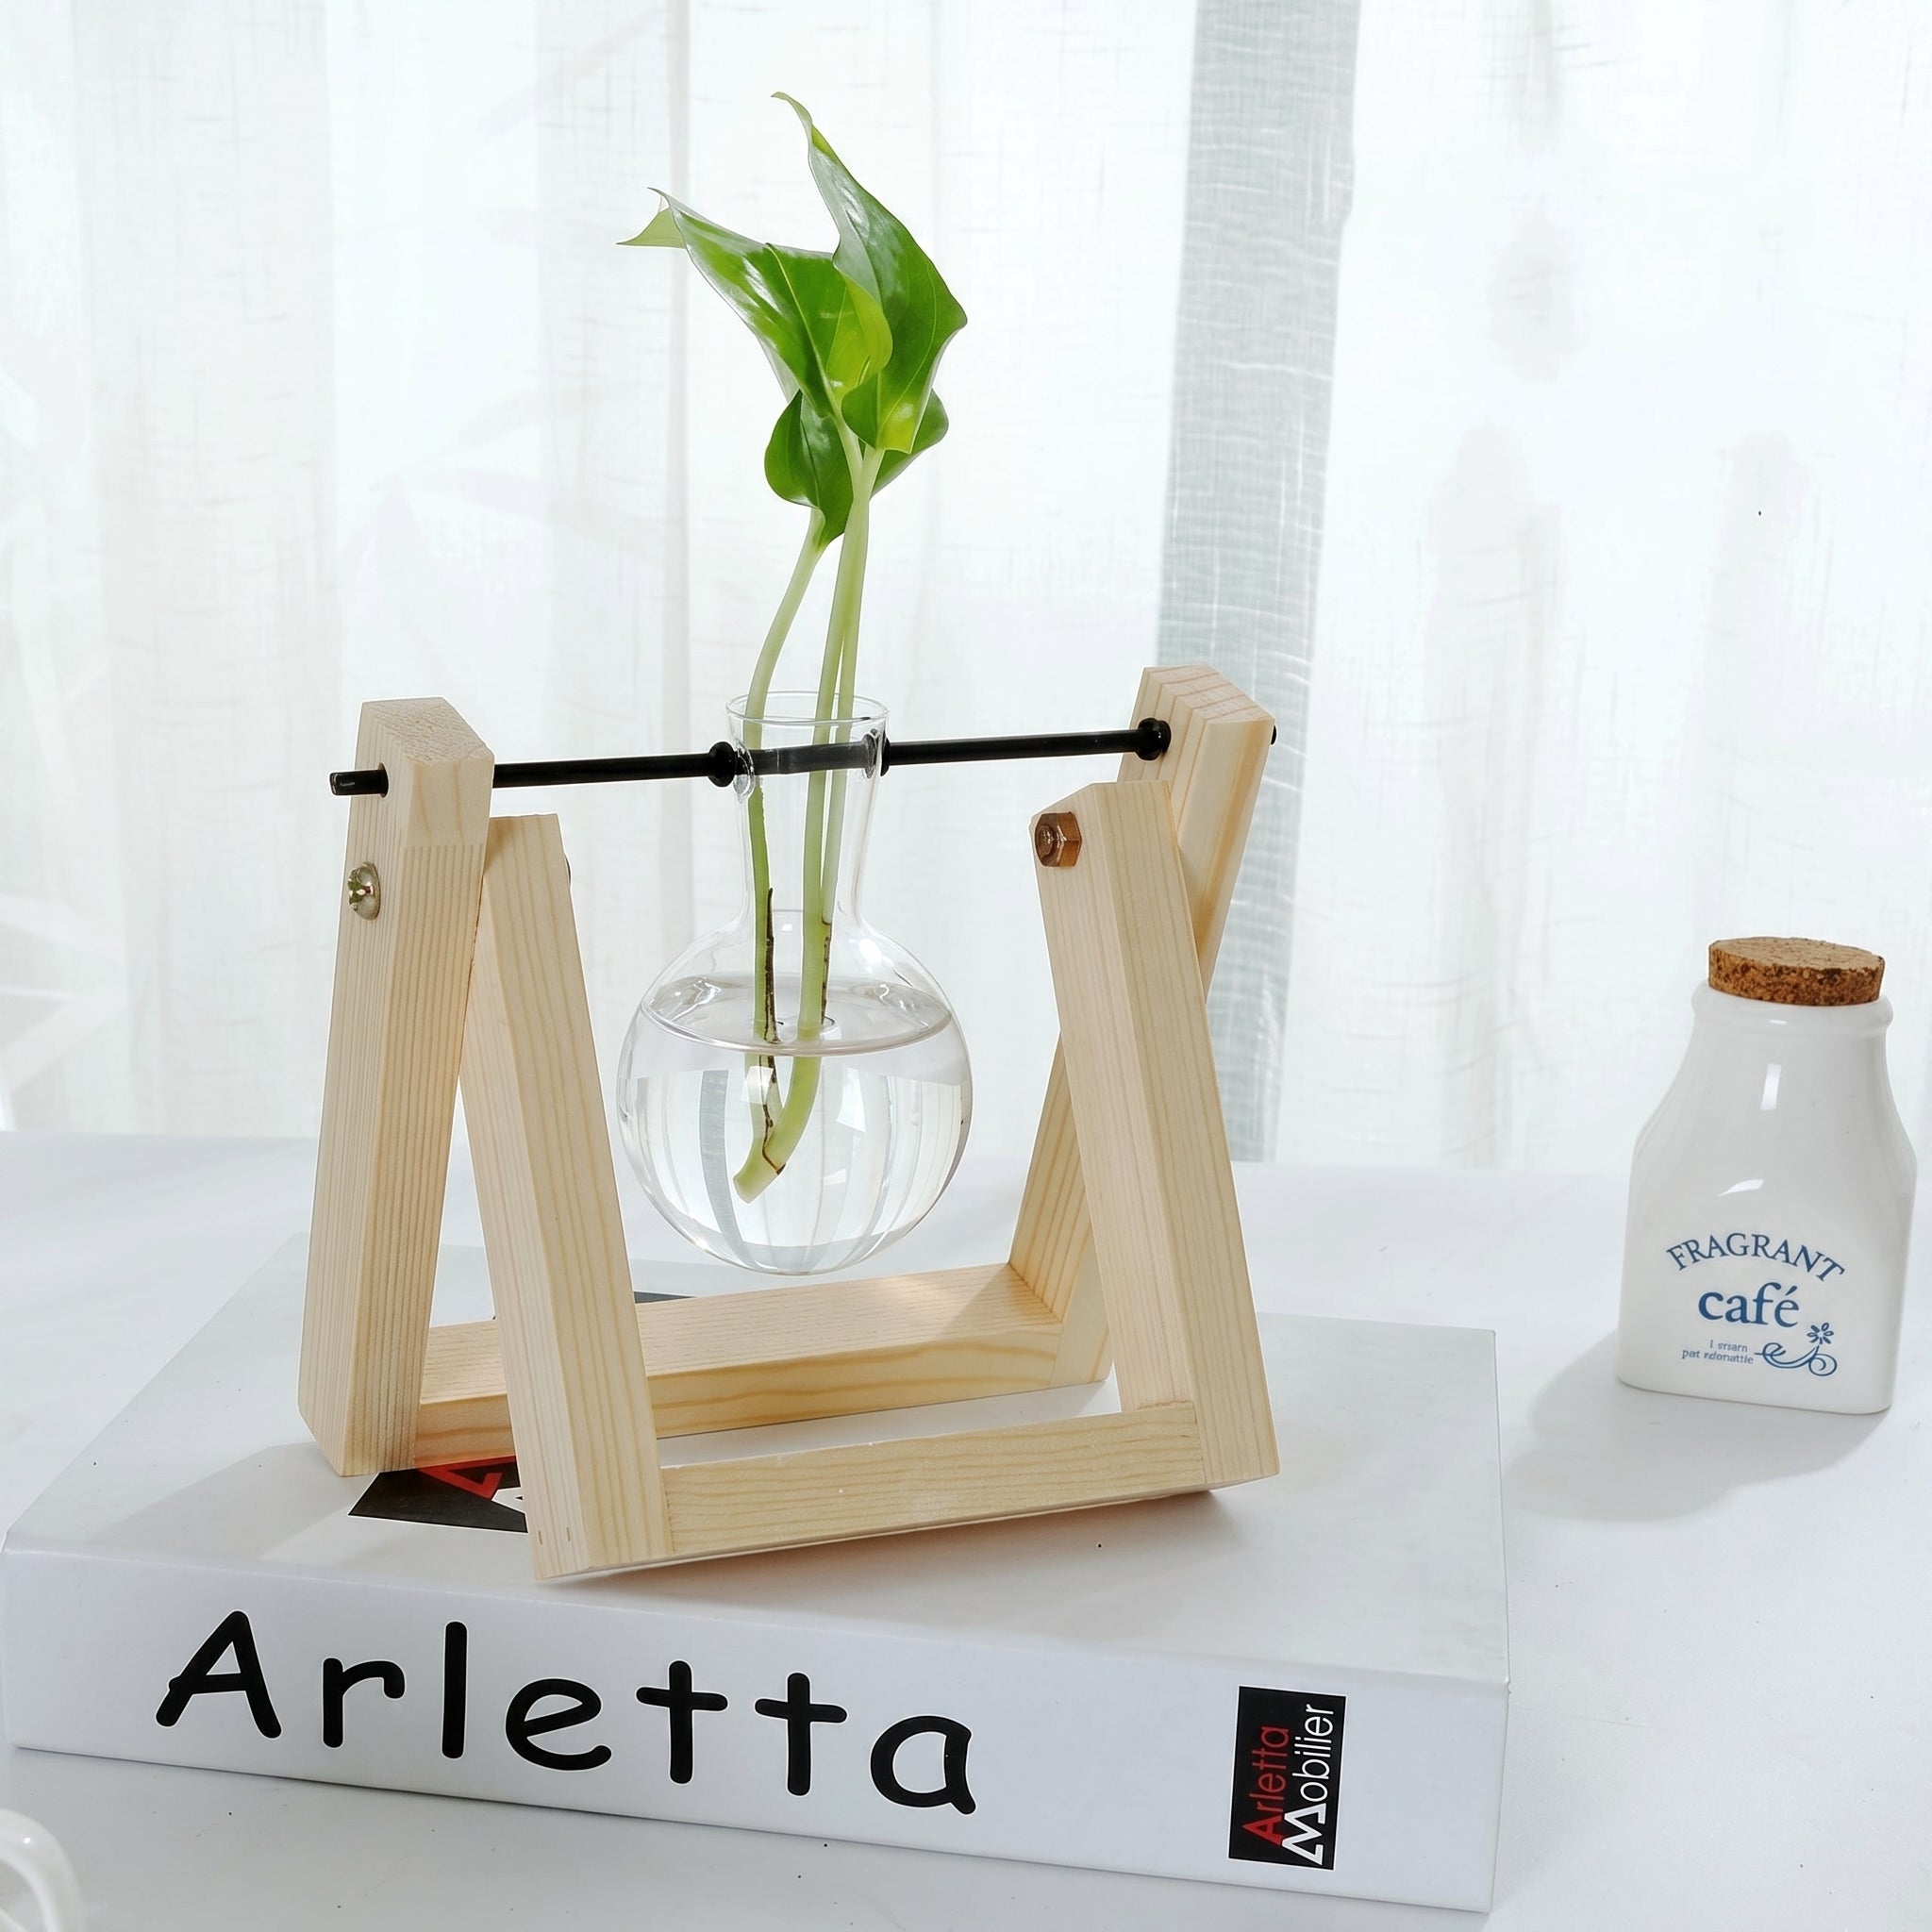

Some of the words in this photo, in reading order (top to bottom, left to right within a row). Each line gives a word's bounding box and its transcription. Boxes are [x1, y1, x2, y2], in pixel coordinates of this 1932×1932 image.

[1666, 1232, 1845, 1281] FRAGRANT
[1698, 1282, 1799, 1328] café
[156, 1611, 976, 1815] Arletta
[1242, 1726, 1289, 1846] Arletta
[1281, 1704, 1334, 1865] Mobilier
